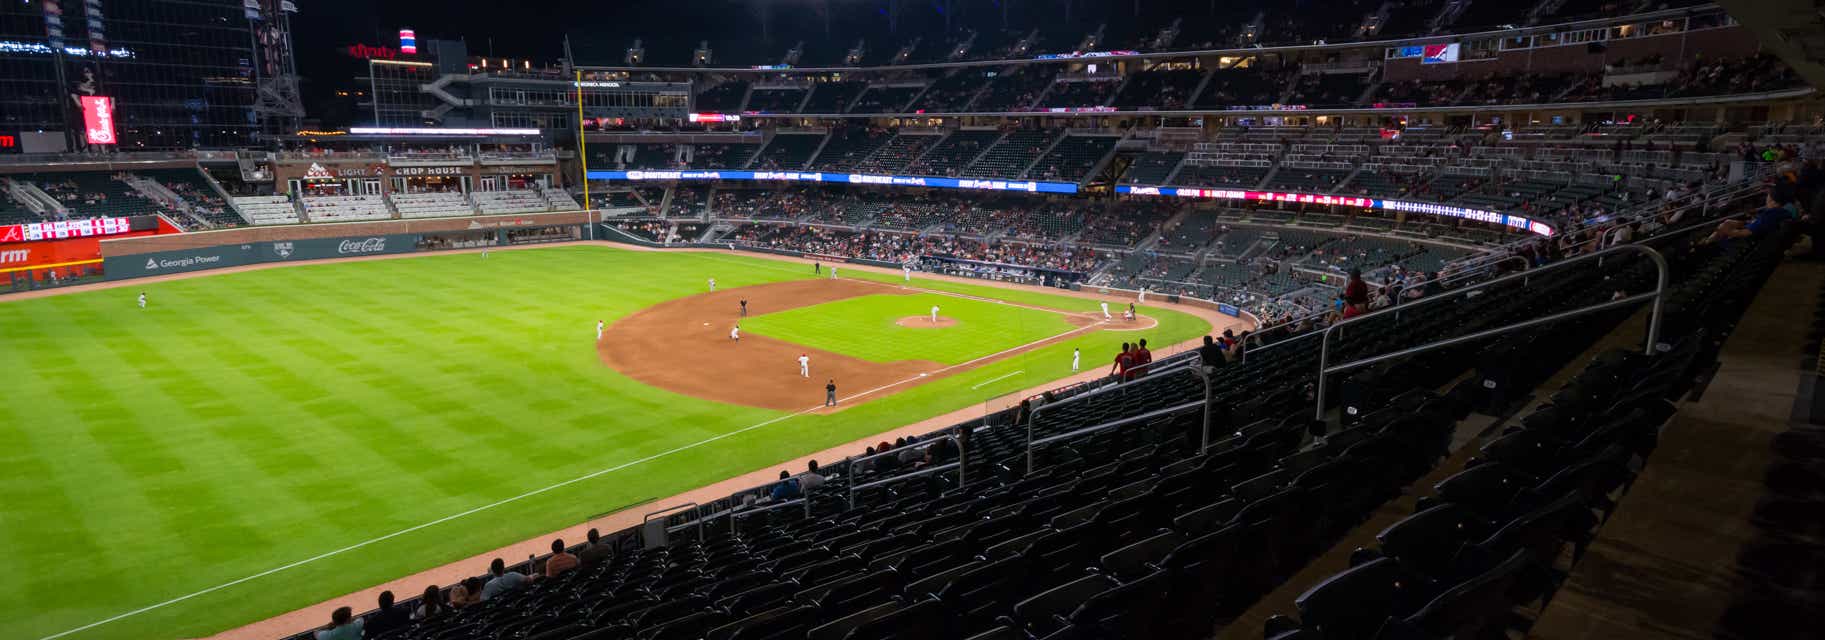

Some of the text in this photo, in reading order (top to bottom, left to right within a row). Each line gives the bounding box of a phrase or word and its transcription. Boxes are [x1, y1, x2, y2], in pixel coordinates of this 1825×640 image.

[338, 168, 368, 176] LIGHT
[395, 166, 462, 175] CHOP HOUSE
[338, 237, 386, 253] Coca-Cola
[160, 255, 219, 268] Georgia Power
